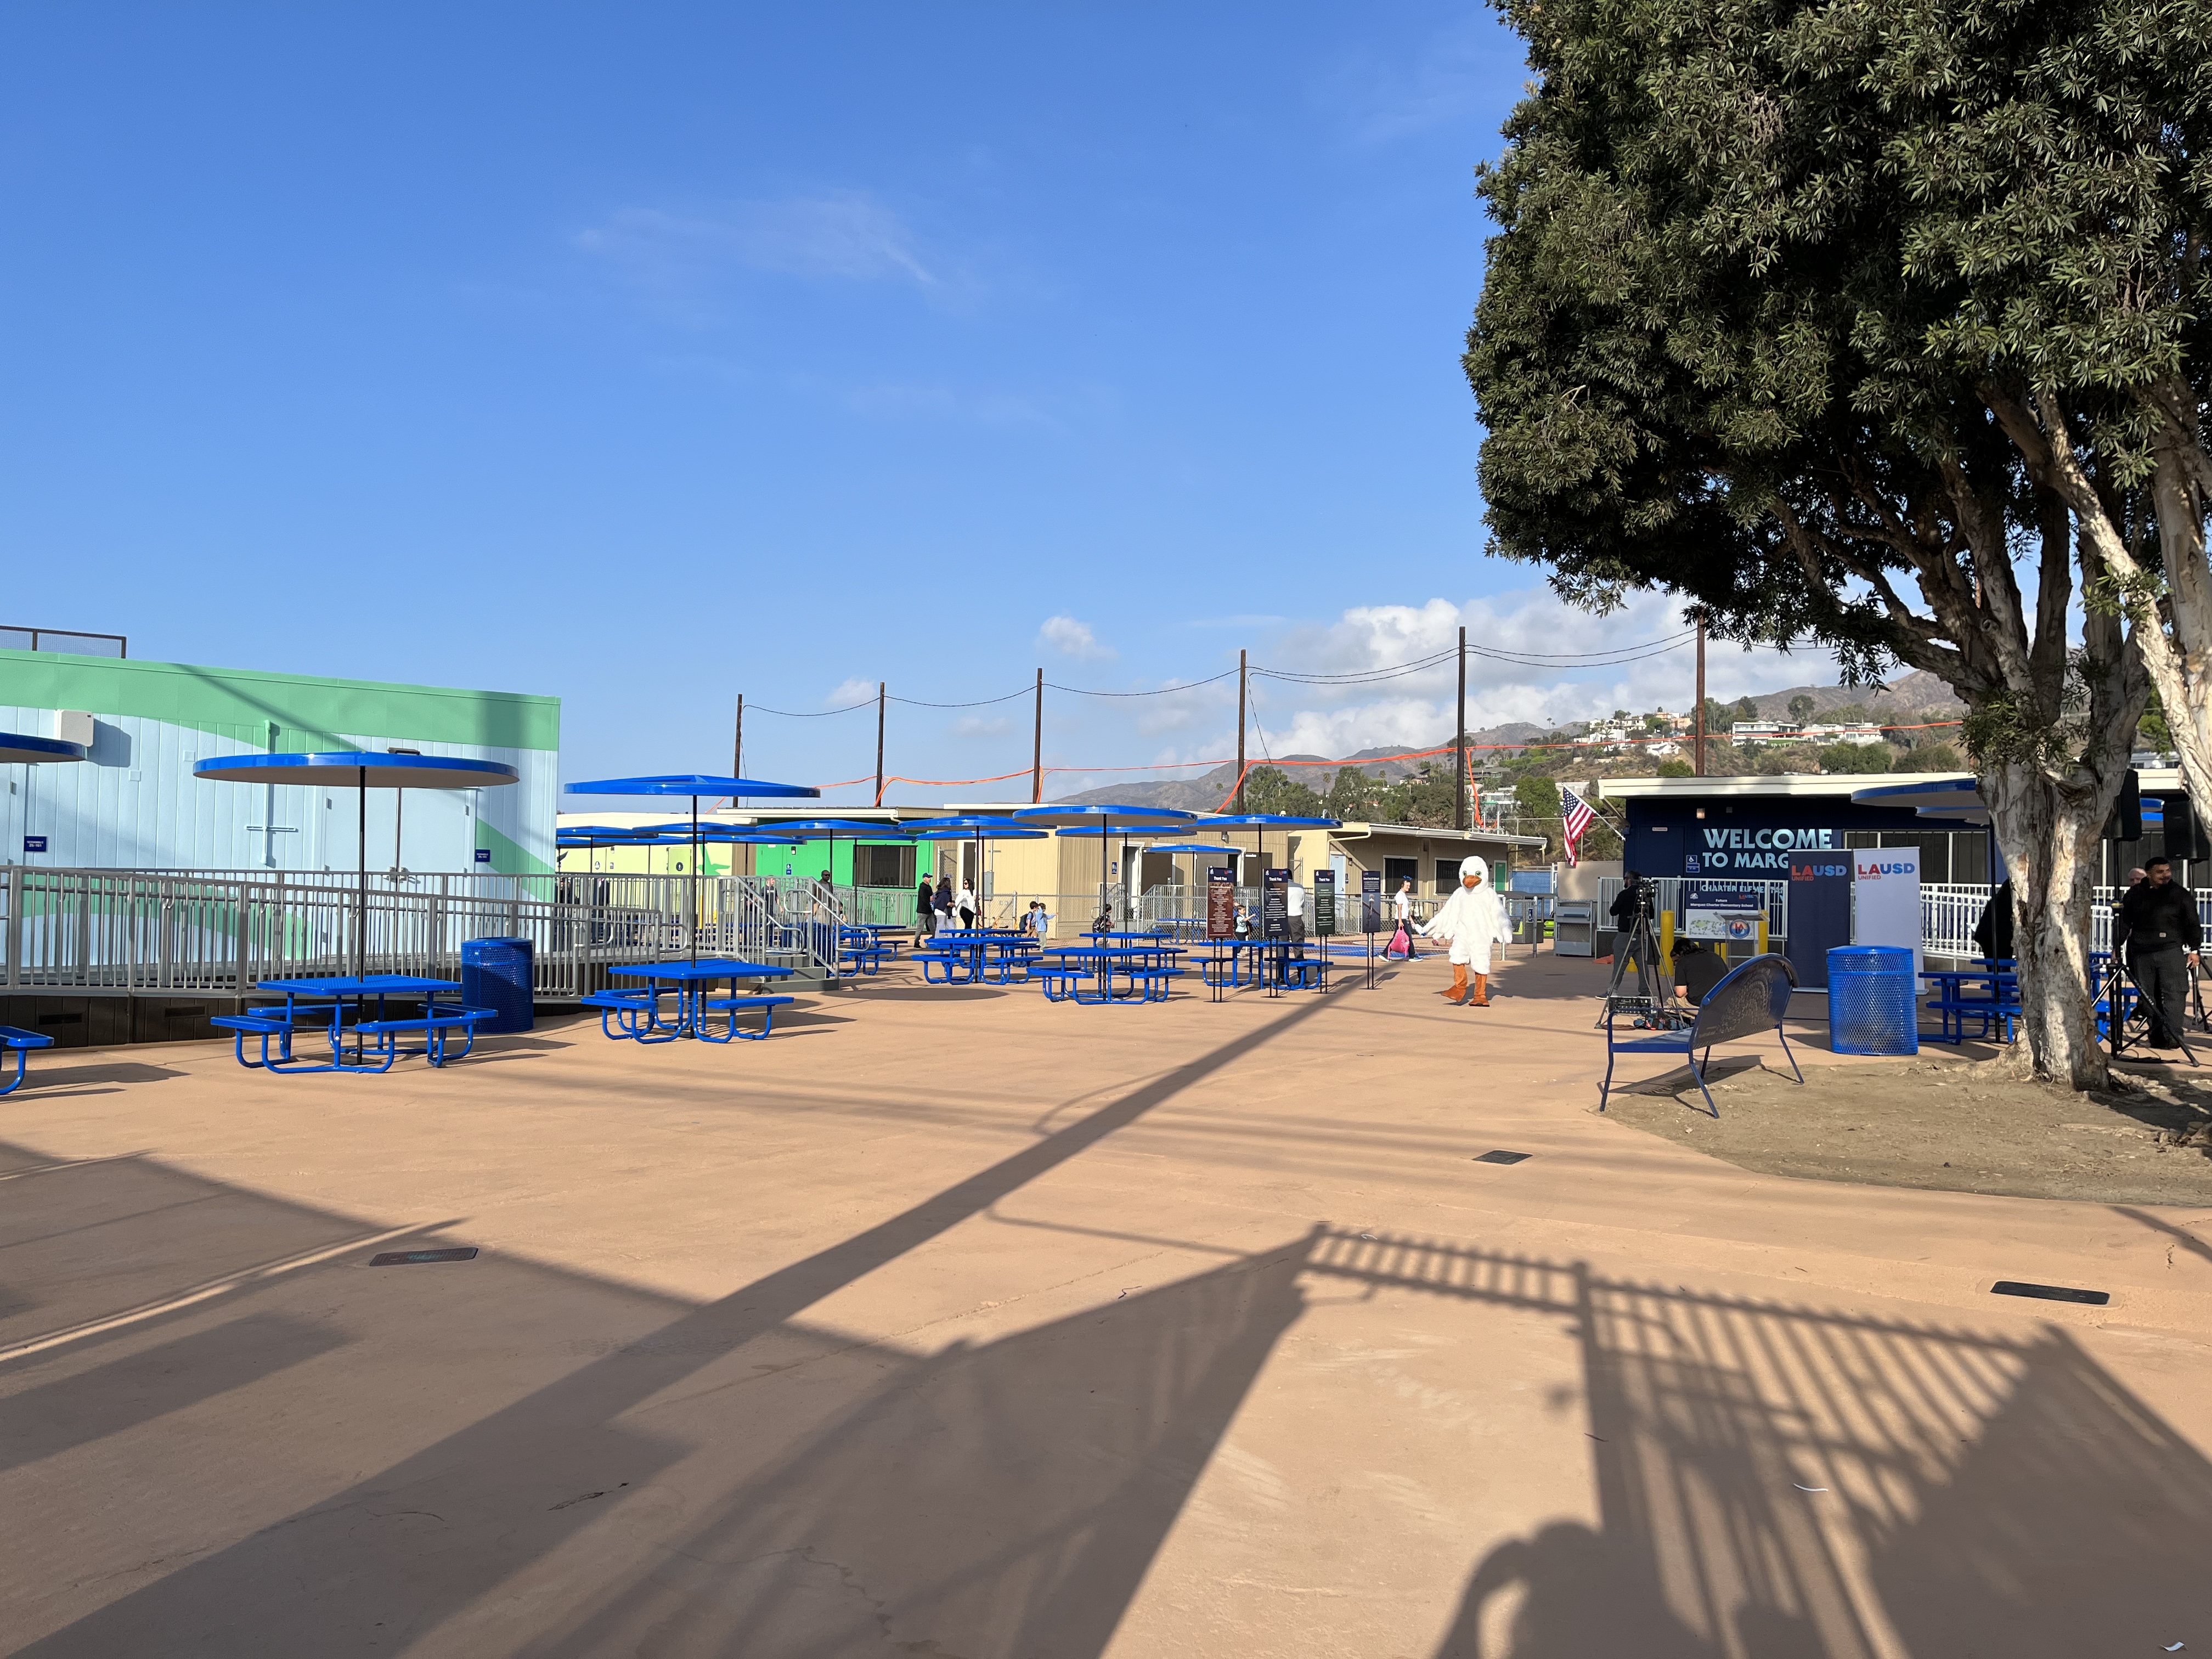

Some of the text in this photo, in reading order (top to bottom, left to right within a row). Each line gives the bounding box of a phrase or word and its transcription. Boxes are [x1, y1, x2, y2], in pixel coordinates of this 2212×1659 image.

[1703, 828, 1832, 849] WELCOME
[1702, 852, 1729, 868] TO
[1791, 865, 1847, 877] LAUSD
[1858, 863, 1915, 874] LAUSD
